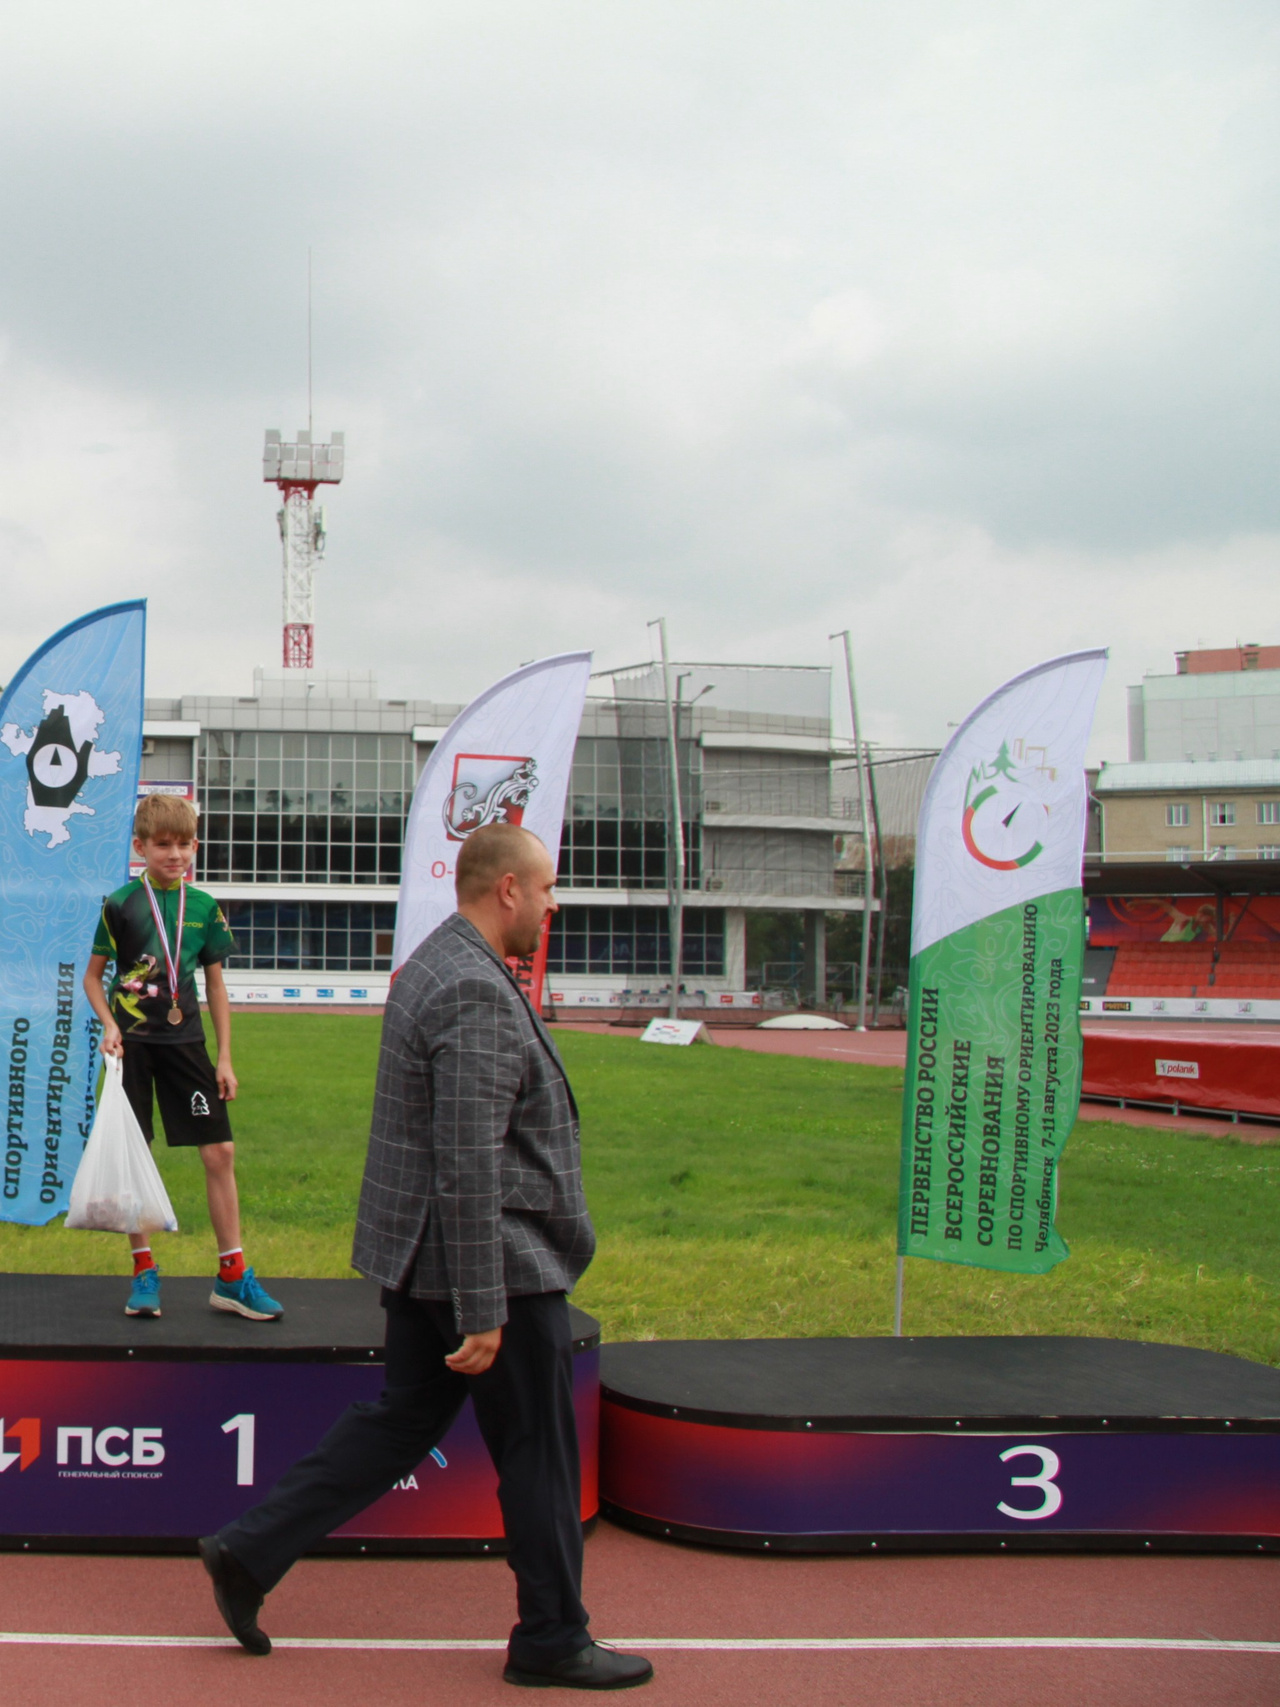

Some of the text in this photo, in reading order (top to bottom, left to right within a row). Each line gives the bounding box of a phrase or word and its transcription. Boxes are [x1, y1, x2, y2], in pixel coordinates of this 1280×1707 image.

[3, 1017, 30, 1199] спортивного
[39, 961, 75, 1204] ориентирования
[910, 987, 939, 1236] ПЕРВЕНСТВО РОССИИ
[944, 1039, 971, 1241] ВСЕРОССИЙСКИЕ
[977, 1055, 1005, 1246] СОРЕВНОВАНИЯ
[1008, 903, 1038, 1251] ПО СПОРТИВНОМУ ОРИЕНТИРОВАНИЮ
[1034, 957, 1064, 1253] Челябинск 7-11 августа 2023 года
[56, 1425, 166, 1467] ПСБ
[57, 1470, 163, 1479] ГЕНЕРАЛЬНЫЙ СПОНСОР
[221, 1413, 255, 1486] 1
[996, 1444, 1063, 1520] 3
